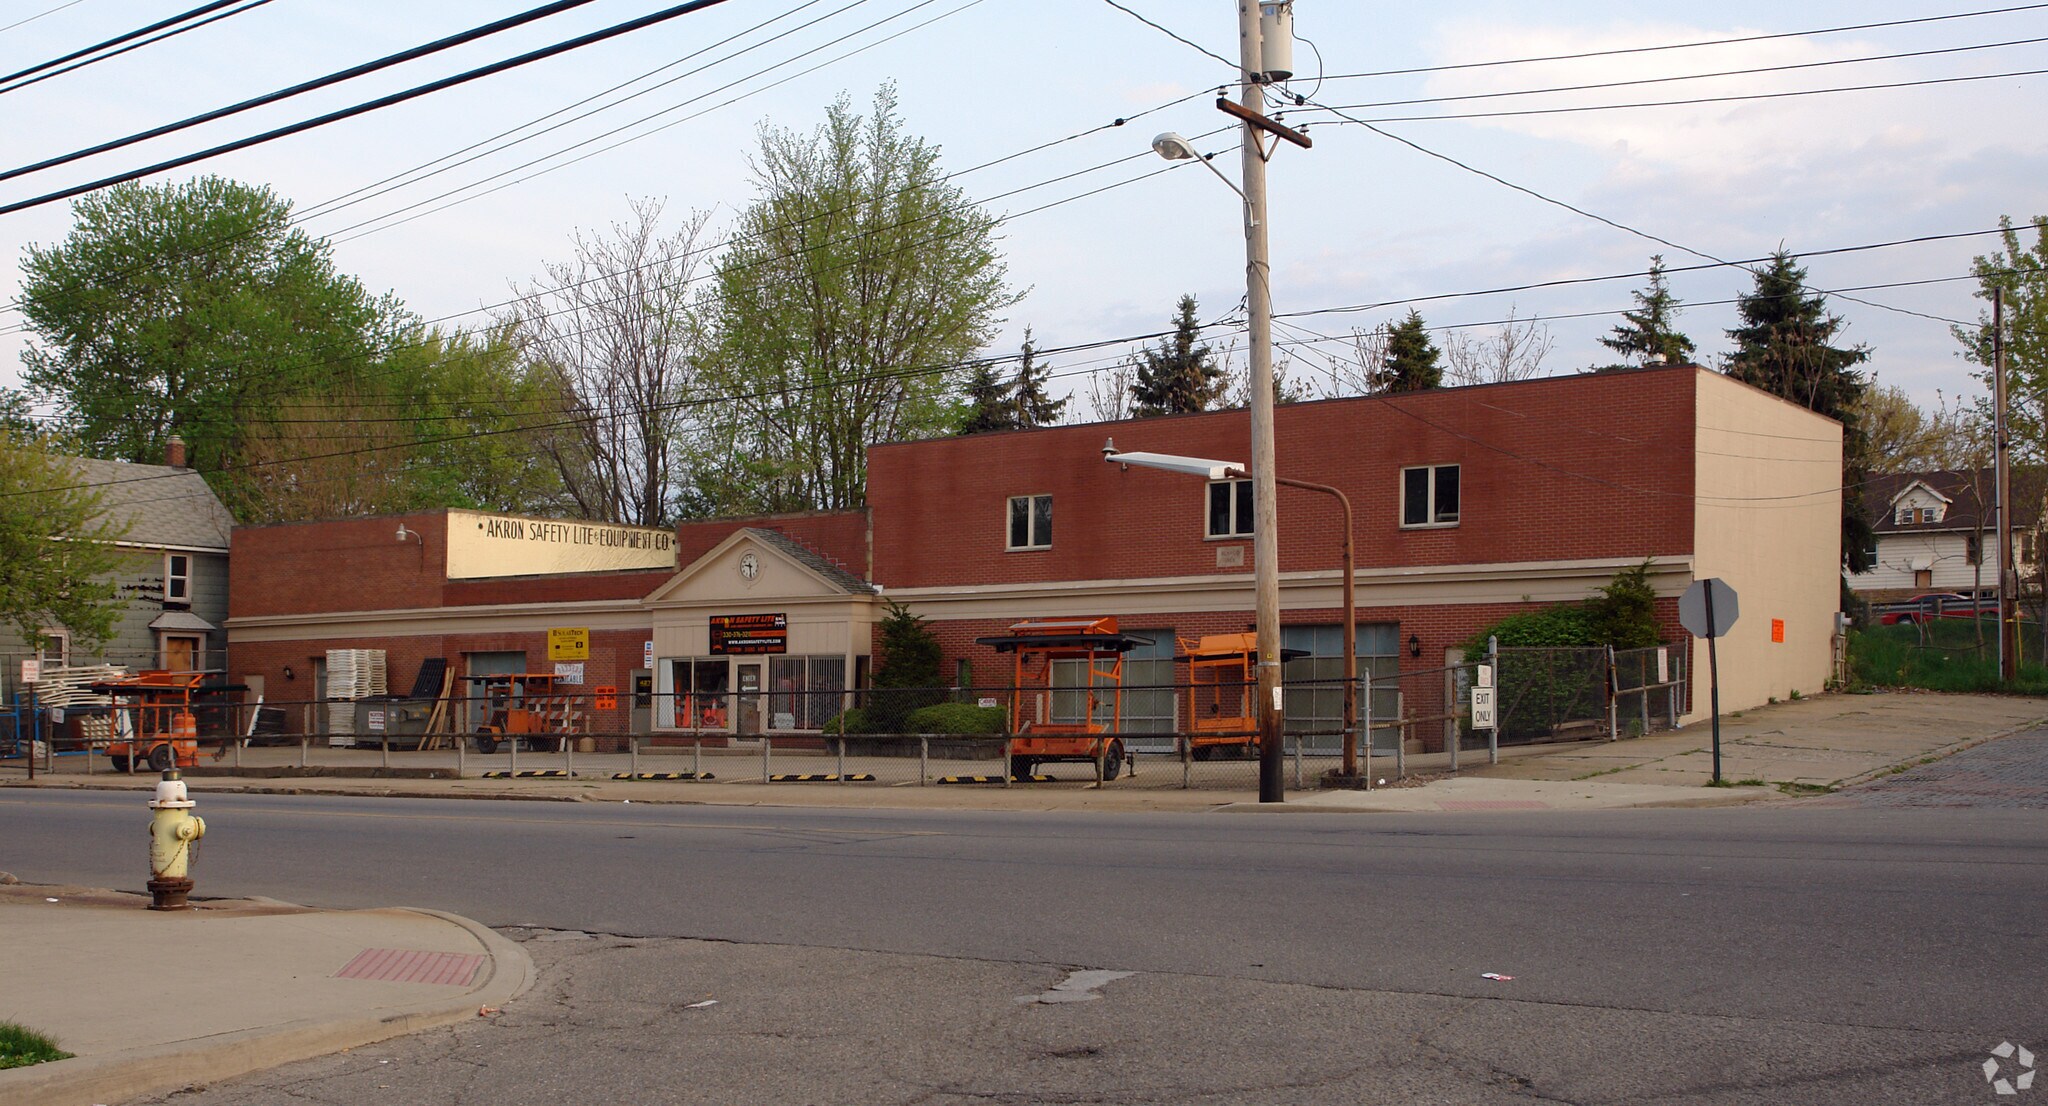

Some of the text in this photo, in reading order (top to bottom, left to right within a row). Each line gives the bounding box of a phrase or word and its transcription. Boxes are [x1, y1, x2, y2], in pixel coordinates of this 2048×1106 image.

[486, 519, 524, 540] AKRON
[529, 523, 570, 543] SAFETY
[573, 526, 594, 545] LITE
[600, 528, 651, 550] EQUIPMENT
[655, 533, 670, 551] CO.
[1476, 694, 1489, 704] EXIT
[1475, 711, 1491, 722] ONLY
